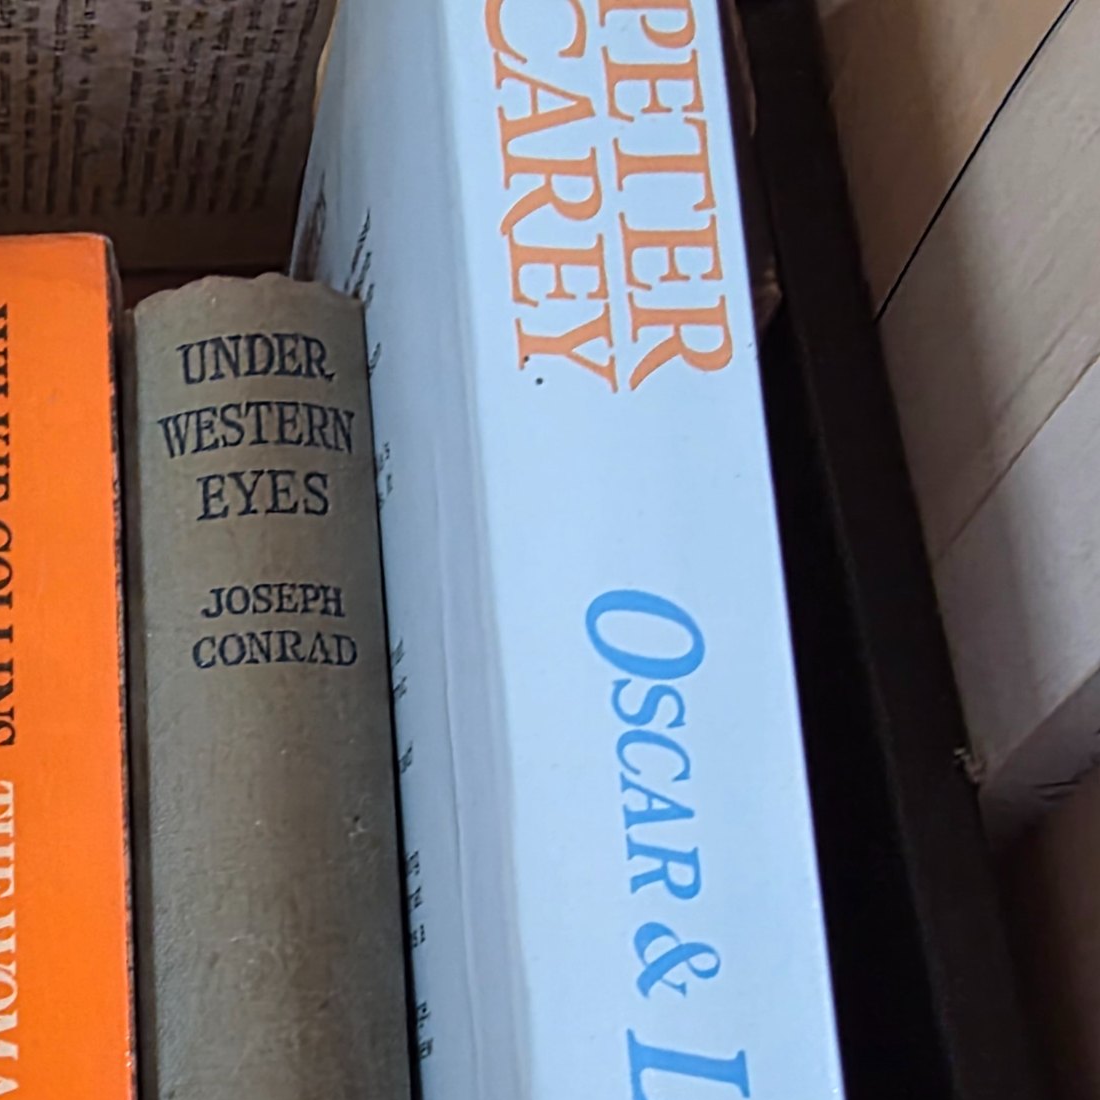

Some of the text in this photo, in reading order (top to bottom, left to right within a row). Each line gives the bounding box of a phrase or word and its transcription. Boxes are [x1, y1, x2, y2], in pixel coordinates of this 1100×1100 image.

[484, 0, 618, 393] CAREY
[600, 0, 733, 391] PETER
[177, 333, 335, 384] UNDER
[158, 401, 354, 458] WESTERN
[197, 469, 330, 521] EYES
[201, 583, 346, 617] JOSEPH
[193, 630, 358, 669] CONRAD
[631, 920, 722, 999] &
